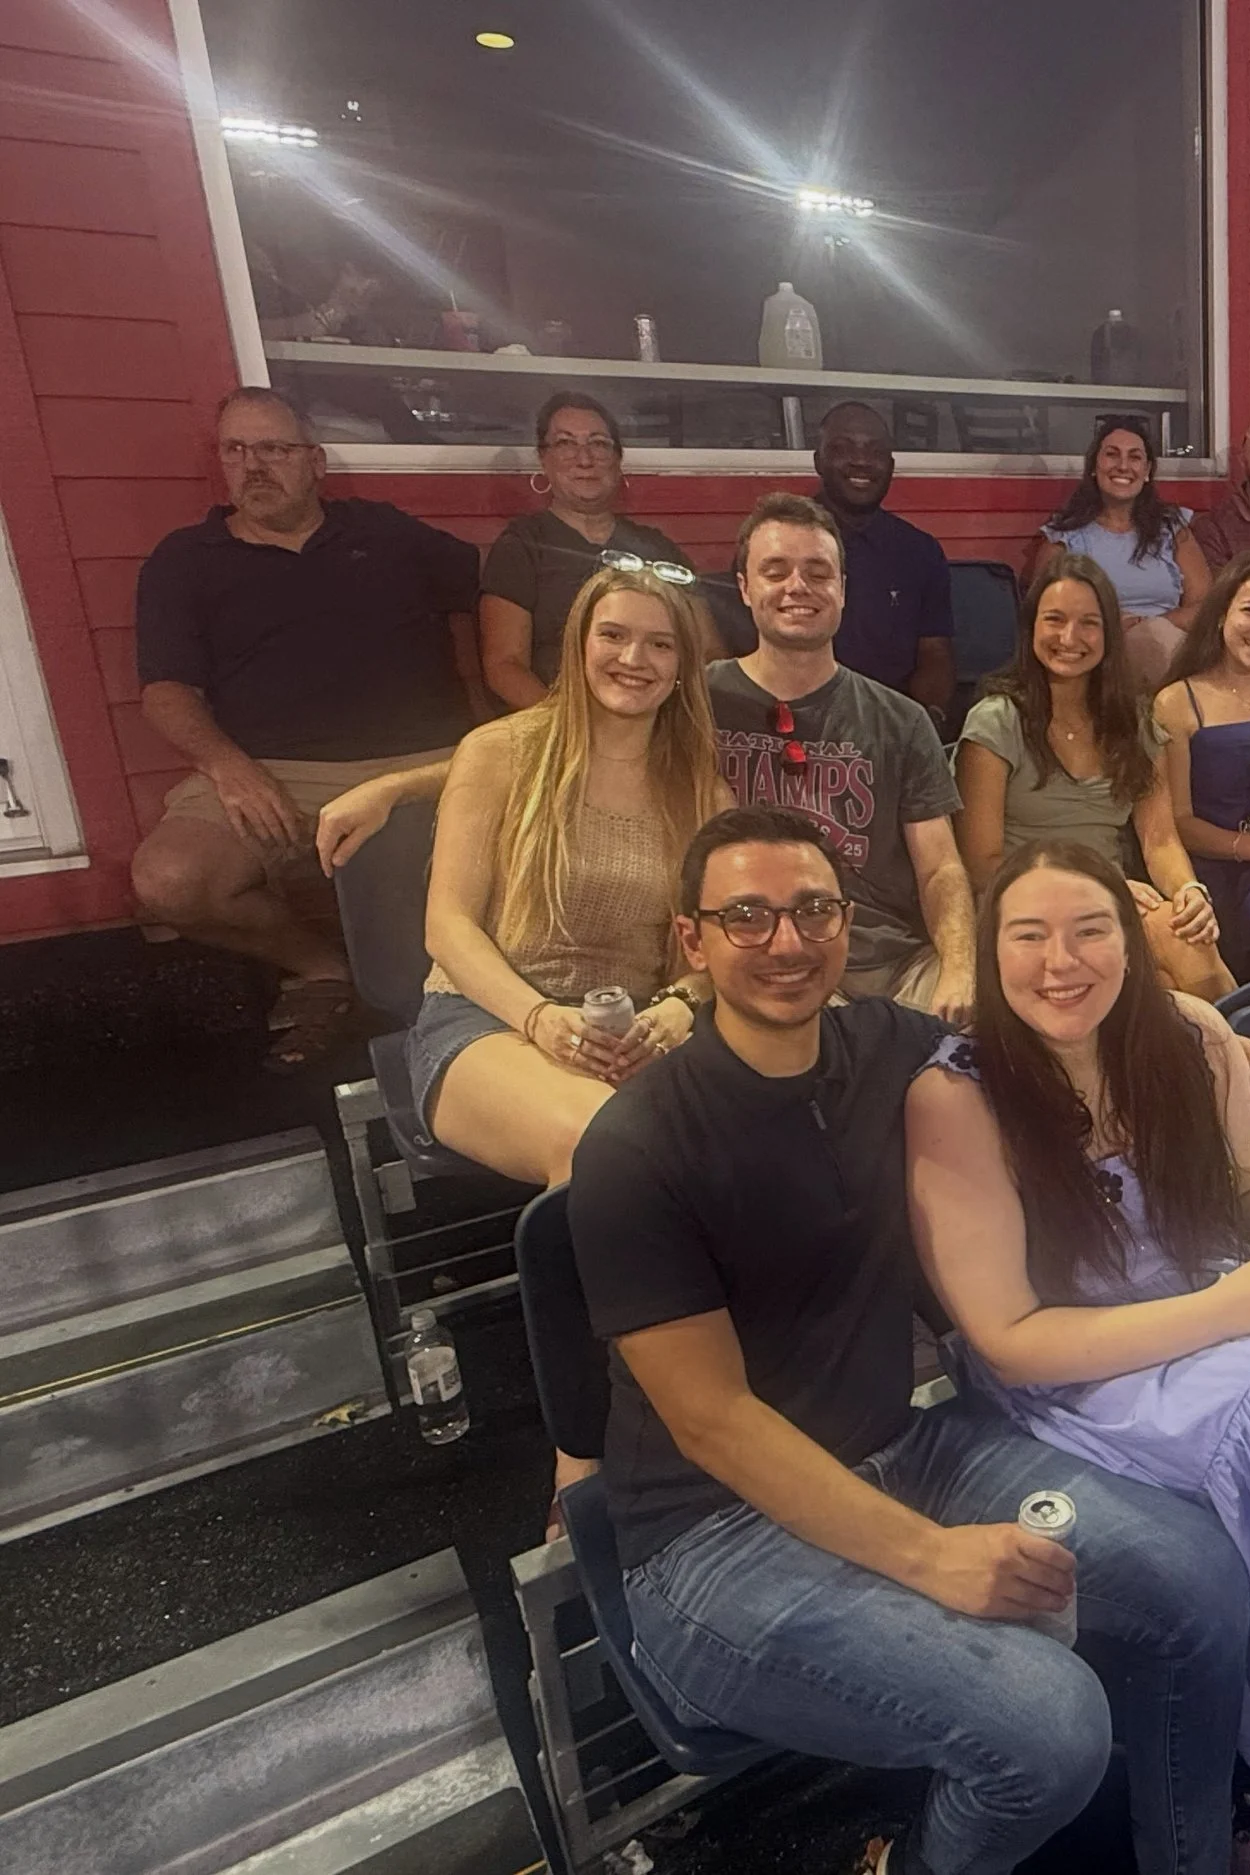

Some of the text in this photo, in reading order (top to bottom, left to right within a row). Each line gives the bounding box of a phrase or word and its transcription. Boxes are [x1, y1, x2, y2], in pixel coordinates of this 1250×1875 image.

[717, 729, 862, 759] NATINAL
[718, 750, 875, 829] HAMPS
[844, 843, 863, 857] 25
